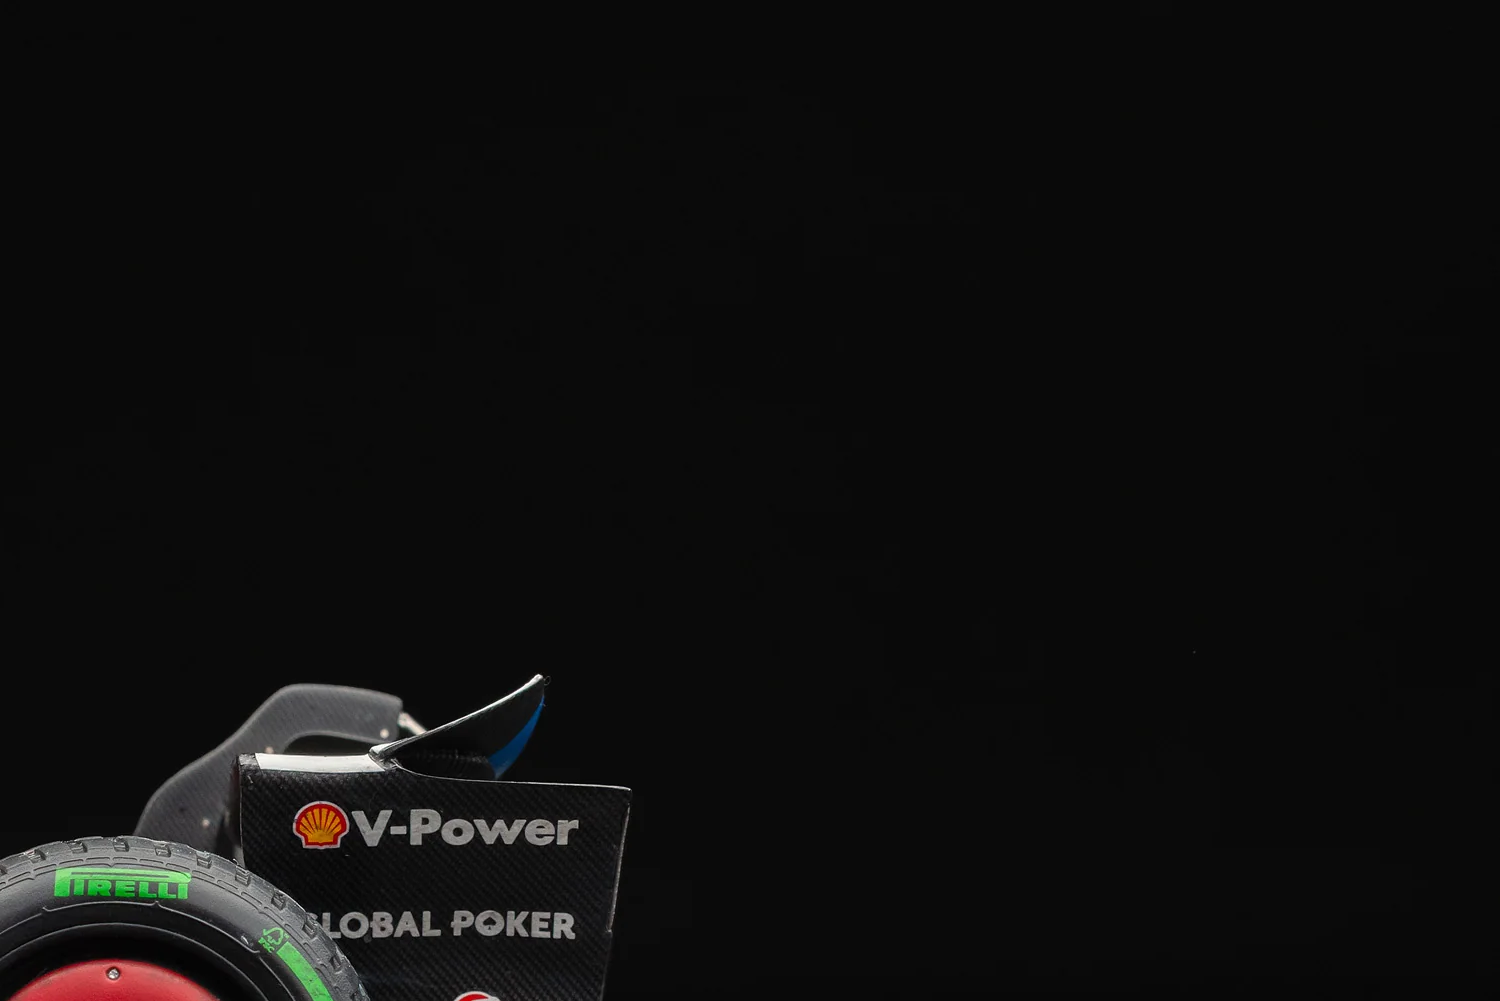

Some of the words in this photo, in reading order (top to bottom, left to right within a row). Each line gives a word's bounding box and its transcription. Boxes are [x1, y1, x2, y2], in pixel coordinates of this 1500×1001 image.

[351, 808, 579, 847] V-Power
[54, 866, 191, 899] PIRELLI
[307, 910, 441, 940] LOBAL
[451, 909, 576, 940] POKER
